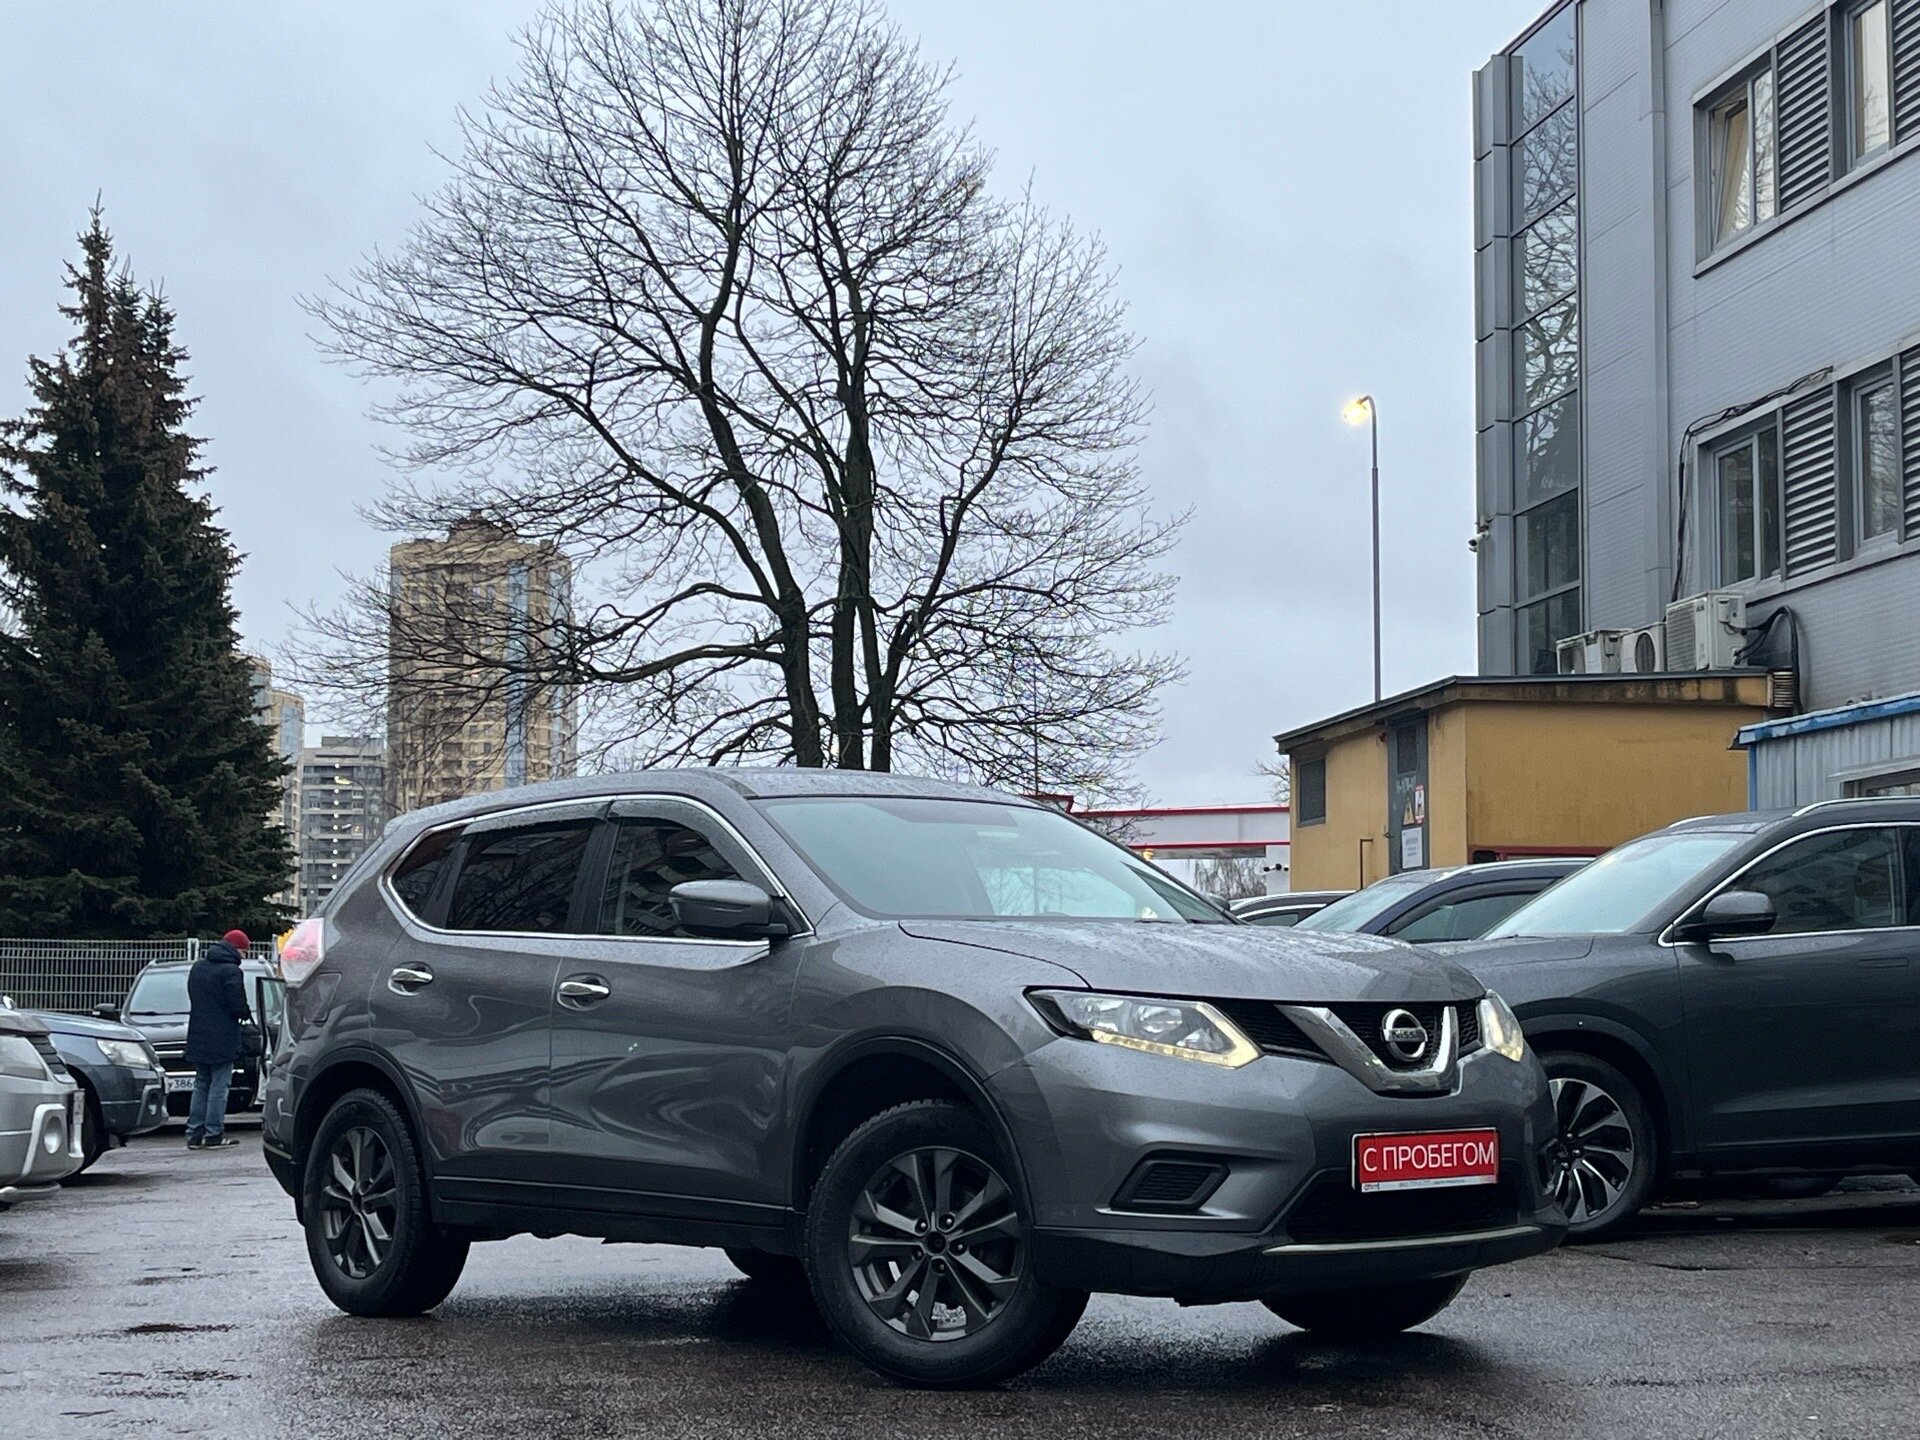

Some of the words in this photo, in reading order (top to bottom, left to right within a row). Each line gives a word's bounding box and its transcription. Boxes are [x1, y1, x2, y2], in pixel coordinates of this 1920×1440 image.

[1391, 1029, 1424, 1040] NISS
[1363, 1147, 1378, 1172] С
[1383, 1141, 1495, 1171] ПРОБЕГОМ
